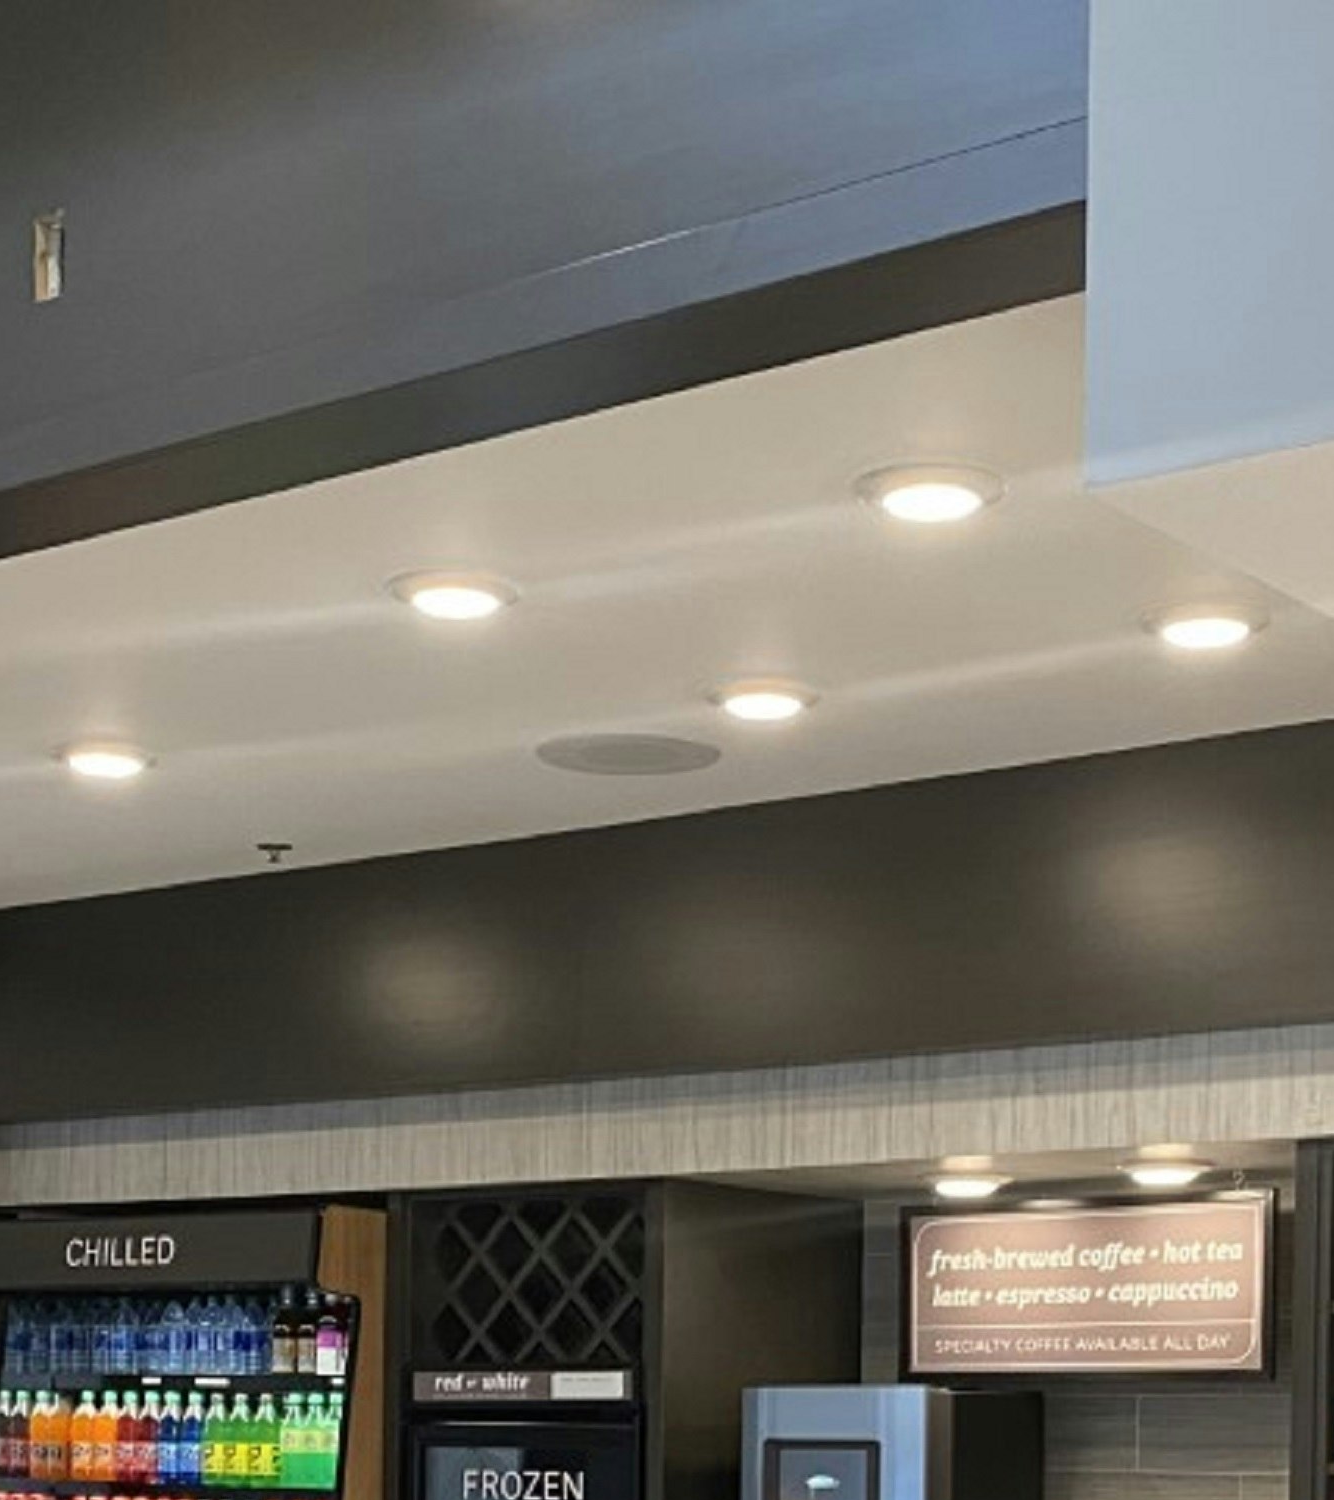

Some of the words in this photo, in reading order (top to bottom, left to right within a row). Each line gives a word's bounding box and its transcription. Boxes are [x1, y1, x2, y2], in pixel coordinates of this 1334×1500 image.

[65, 1234, 175, 1267] CHILLED
[925, 1243, 1075, 1278] fresh-brewed
[1079, 1240, 1145, 1272] coffee
[1163, 1238, 1202, 1264] hot
[1206, 1240, 1244, 1263] tea
[932, 1283, 982, 1308] latte
[995, 1286, 1092, 1311] espresso
[1107, 1276, 1239, 1308] cappuccino
[934, 1338, 1012, 1355] SPECIALTY
[1014, 1337, 1070, 1353] COFFEE
[1074, 1335, 1158, 1352] AVAILABLE
[1163, 1334, 1193, 1351] ALL
[1197, 1332, 1233, 1351] DAY
